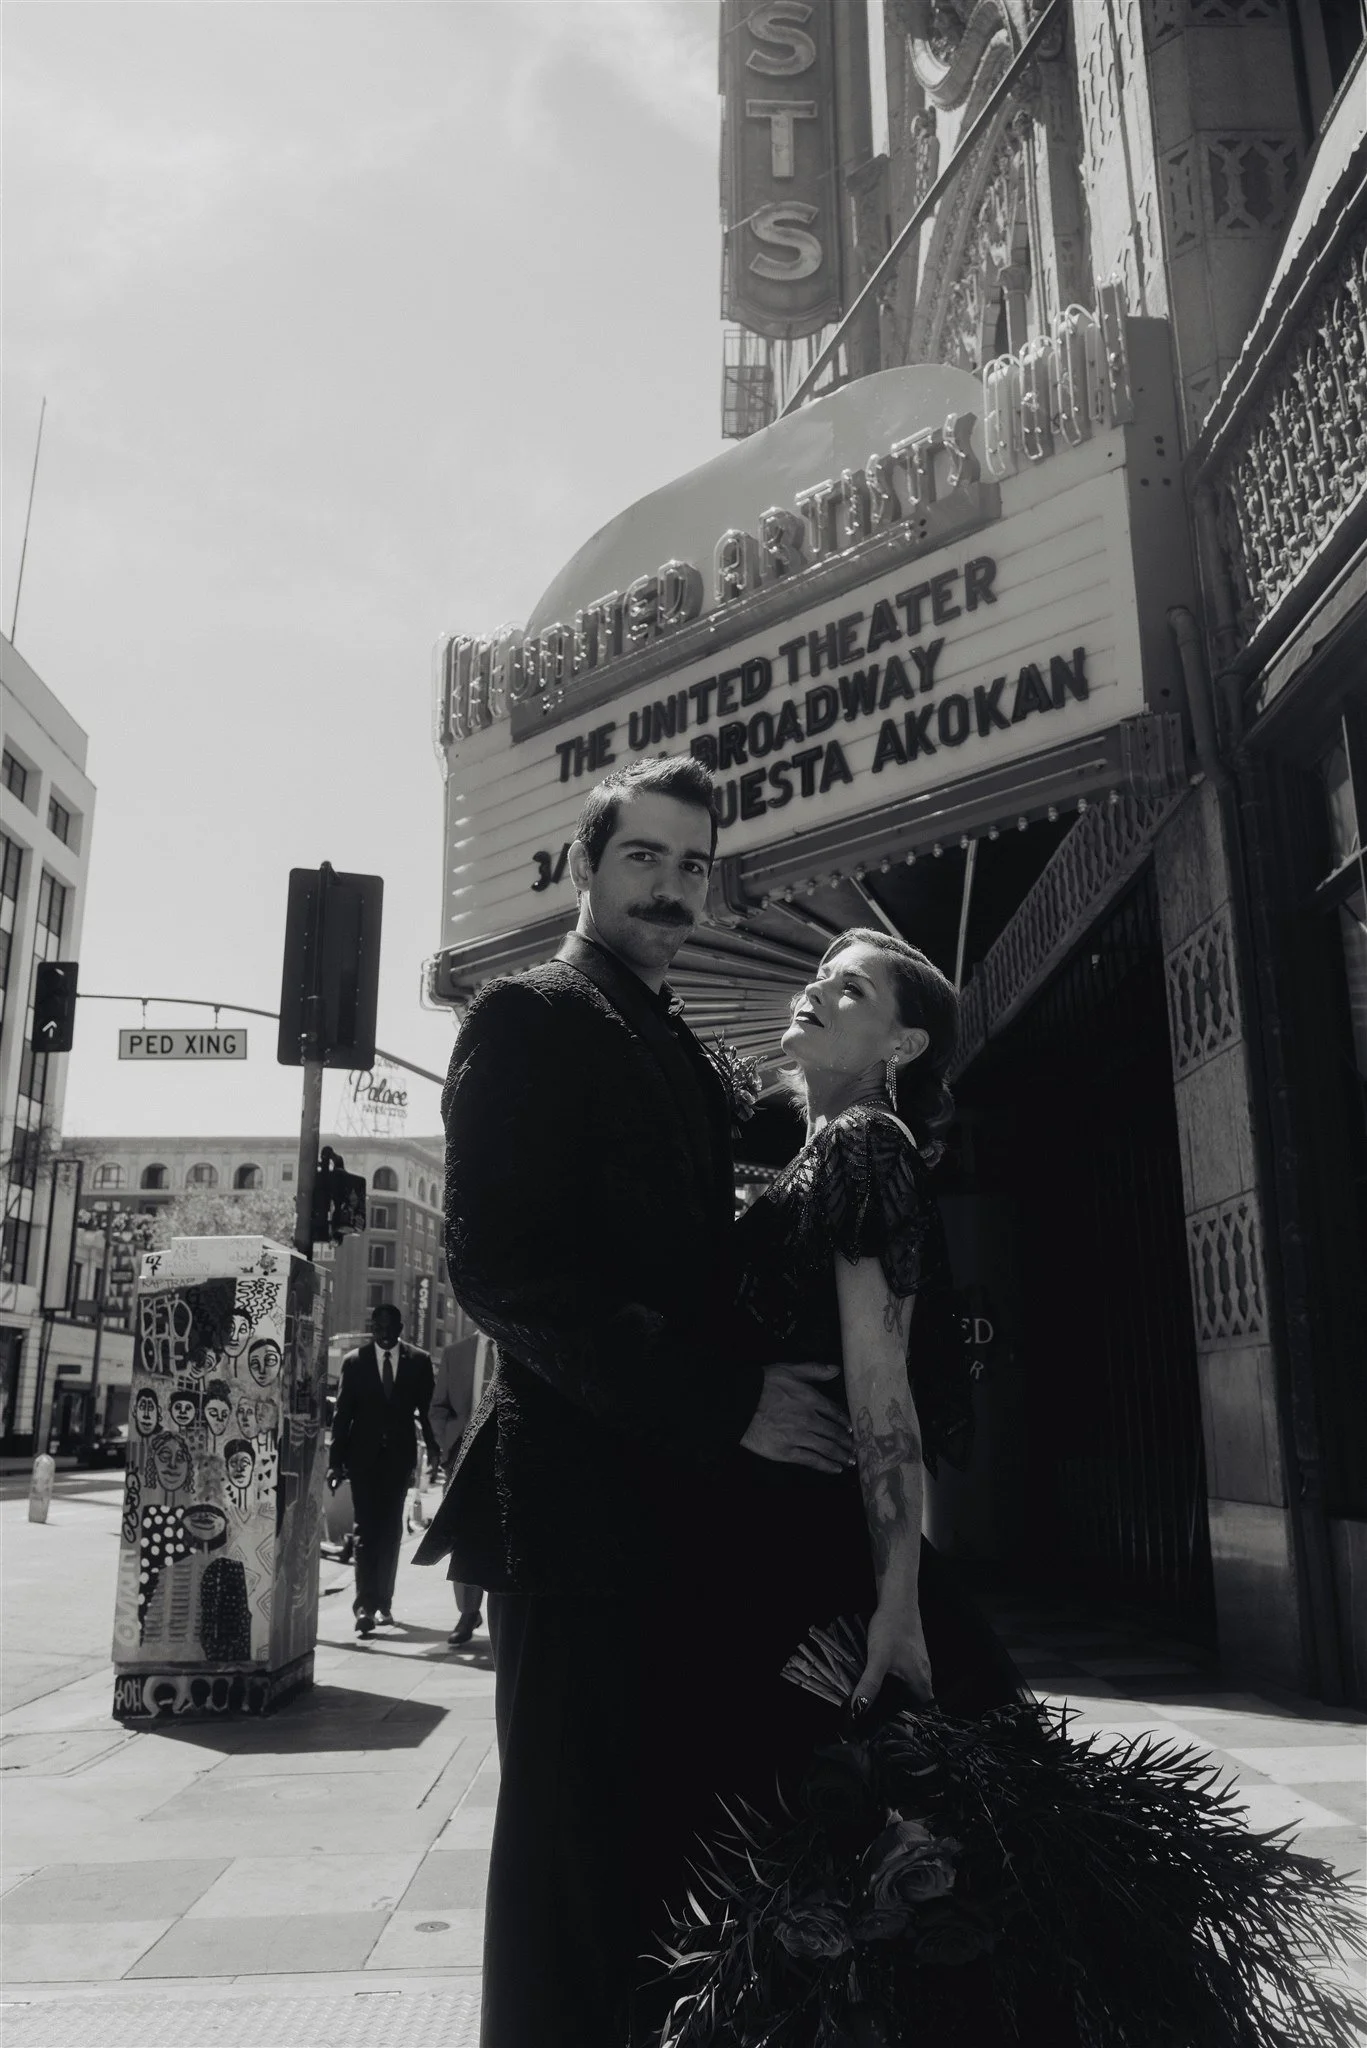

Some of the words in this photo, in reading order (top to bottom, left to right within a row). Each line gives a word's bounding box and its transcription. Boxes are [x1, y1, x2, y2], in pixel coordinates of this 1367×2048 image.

[507, 559, 703, 703] UNITED
[713, 411, 980, 604] ARTISTS
[555, 721, 617, 783] THE
[628, 656, 772, 751] UNITED
[778, 555, 998, 686] THEATER
[690, 636, 946, 772] BROADWAY
[712, 739, 853, 829] UESTA
[871, 645, 1090, 774] AKOKAN
[530, 842, 574, 892] 3/
[129, 1034, 174, 1055] PED
[184, 1034, 237, 1055] XING
[348, 1069, 408, 1107] Palace
[418, 1287, 429, 1309] CVS
